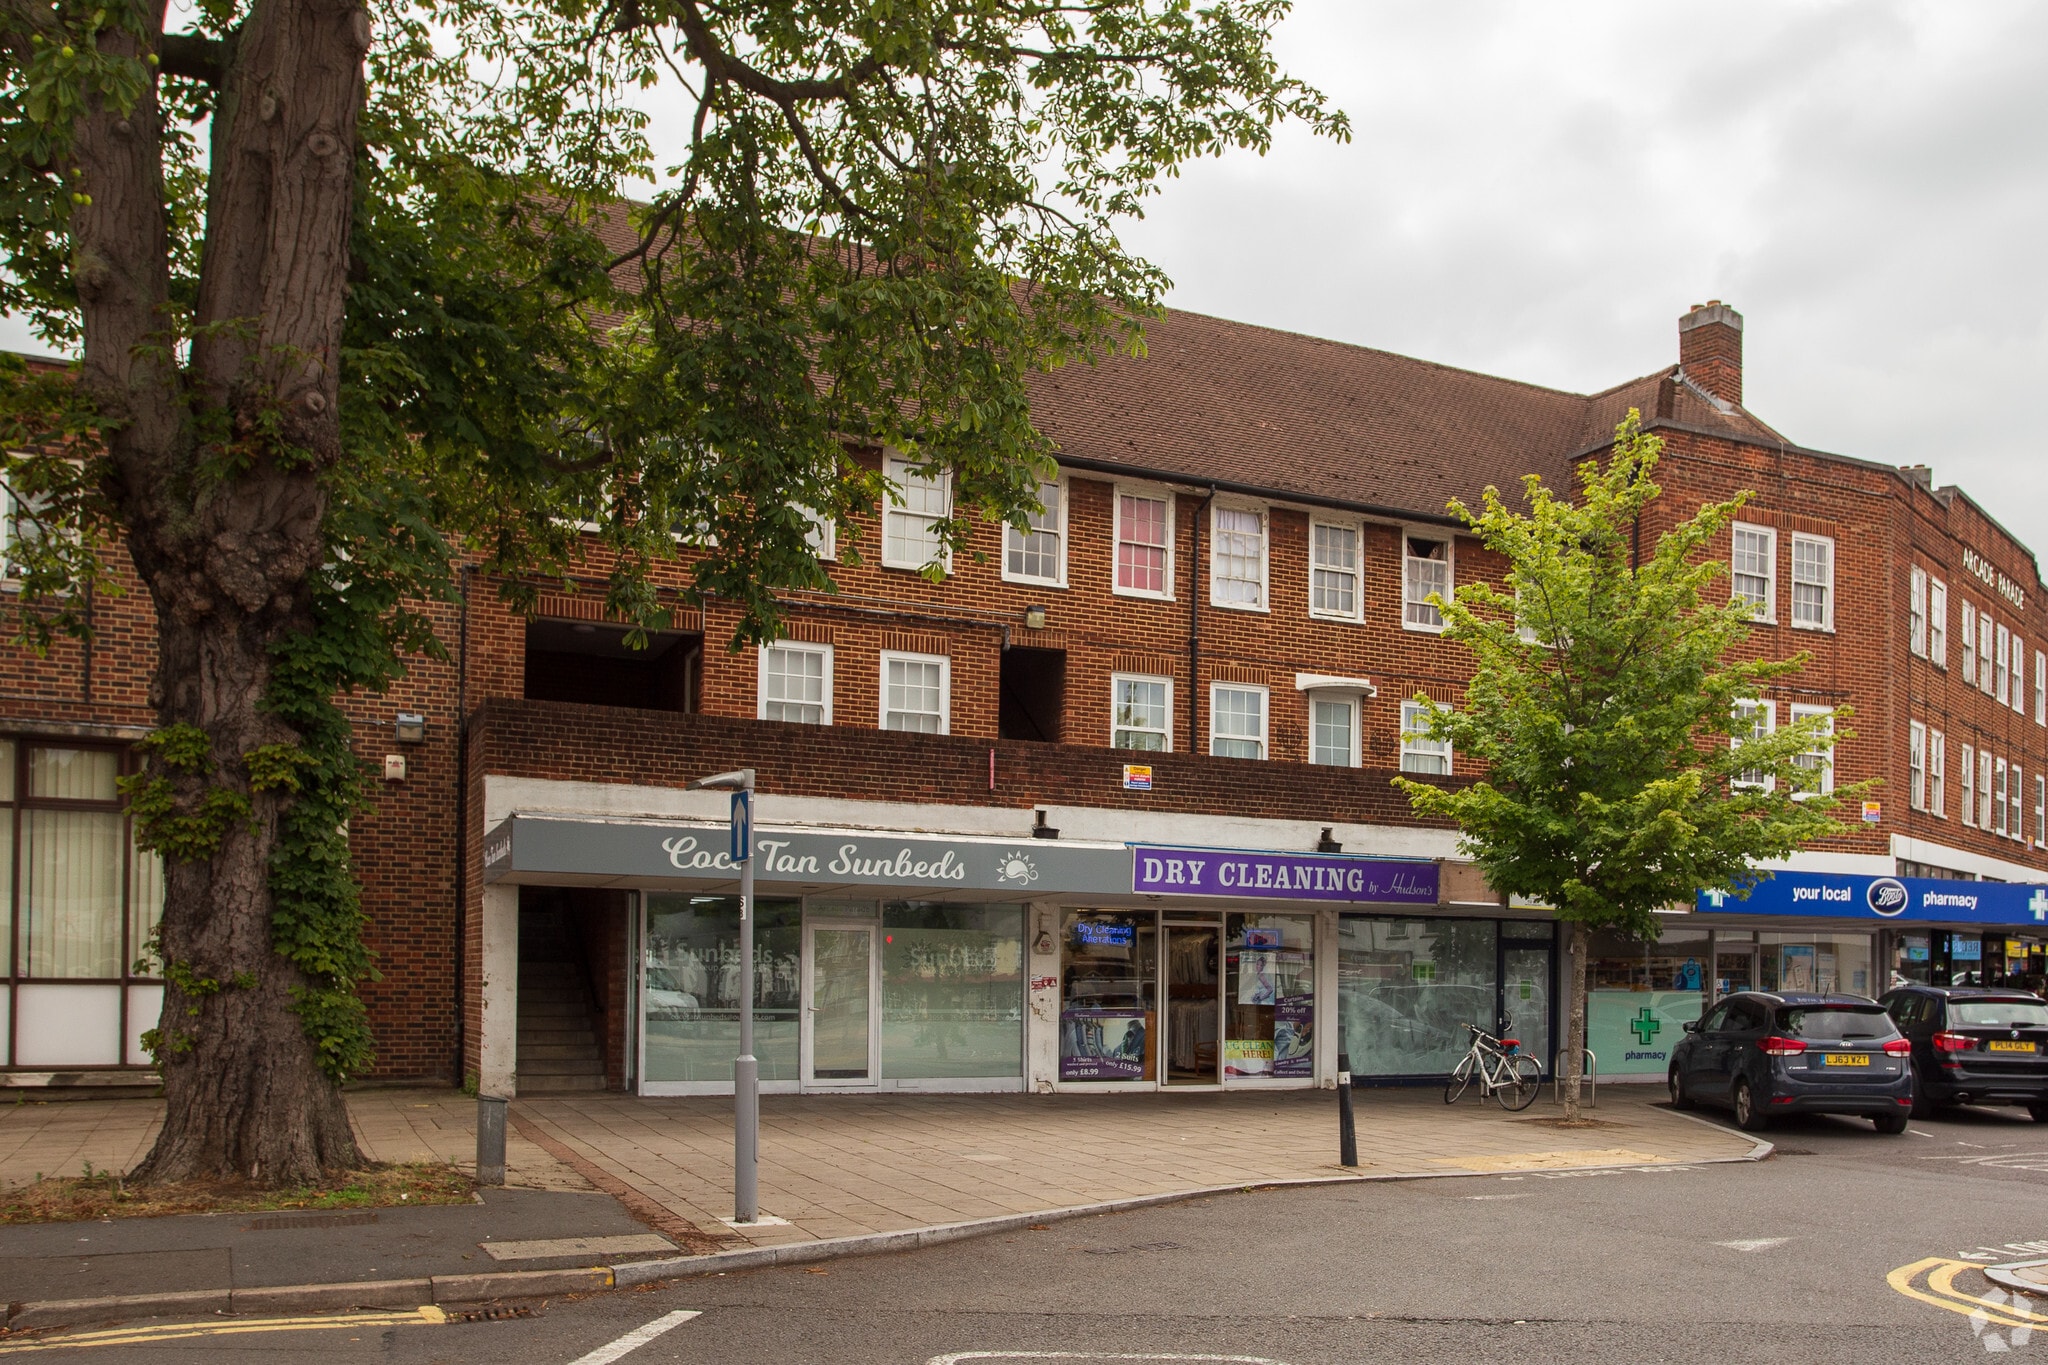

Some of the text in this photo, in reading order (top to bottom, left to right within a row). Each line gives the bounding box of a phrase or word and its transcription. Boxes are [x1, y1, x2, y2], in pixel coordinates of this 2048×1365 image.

[1963, 547, 2024, 610] ARCADE PARADE
[662, 836, 965, 880] Coc Tan Sunbeds
[1143, 858, 1433, 896] DRY CLEANING by Hudson's
[1793, 885, 1851, 902] your local
[1876, 886, 1903, 906] Boots
[1923, 891, 1977, 910] pharmacy
[1078, 924, 1132, 936] Dry Cleaning
[1082, 936, 1127, 945] Alterations
[1121, 1052, 1139, 1062] Suits
[1243, 1050, 1271, 1059] HERE!
[1625, 1051, 1666, 1062] pharmacy
[1826, 1055, 1848, 1064] LJ63
[1066, 1068, 1099, 1077] only £8.99
[1119, 1062, 1142, 1073] £15.99
